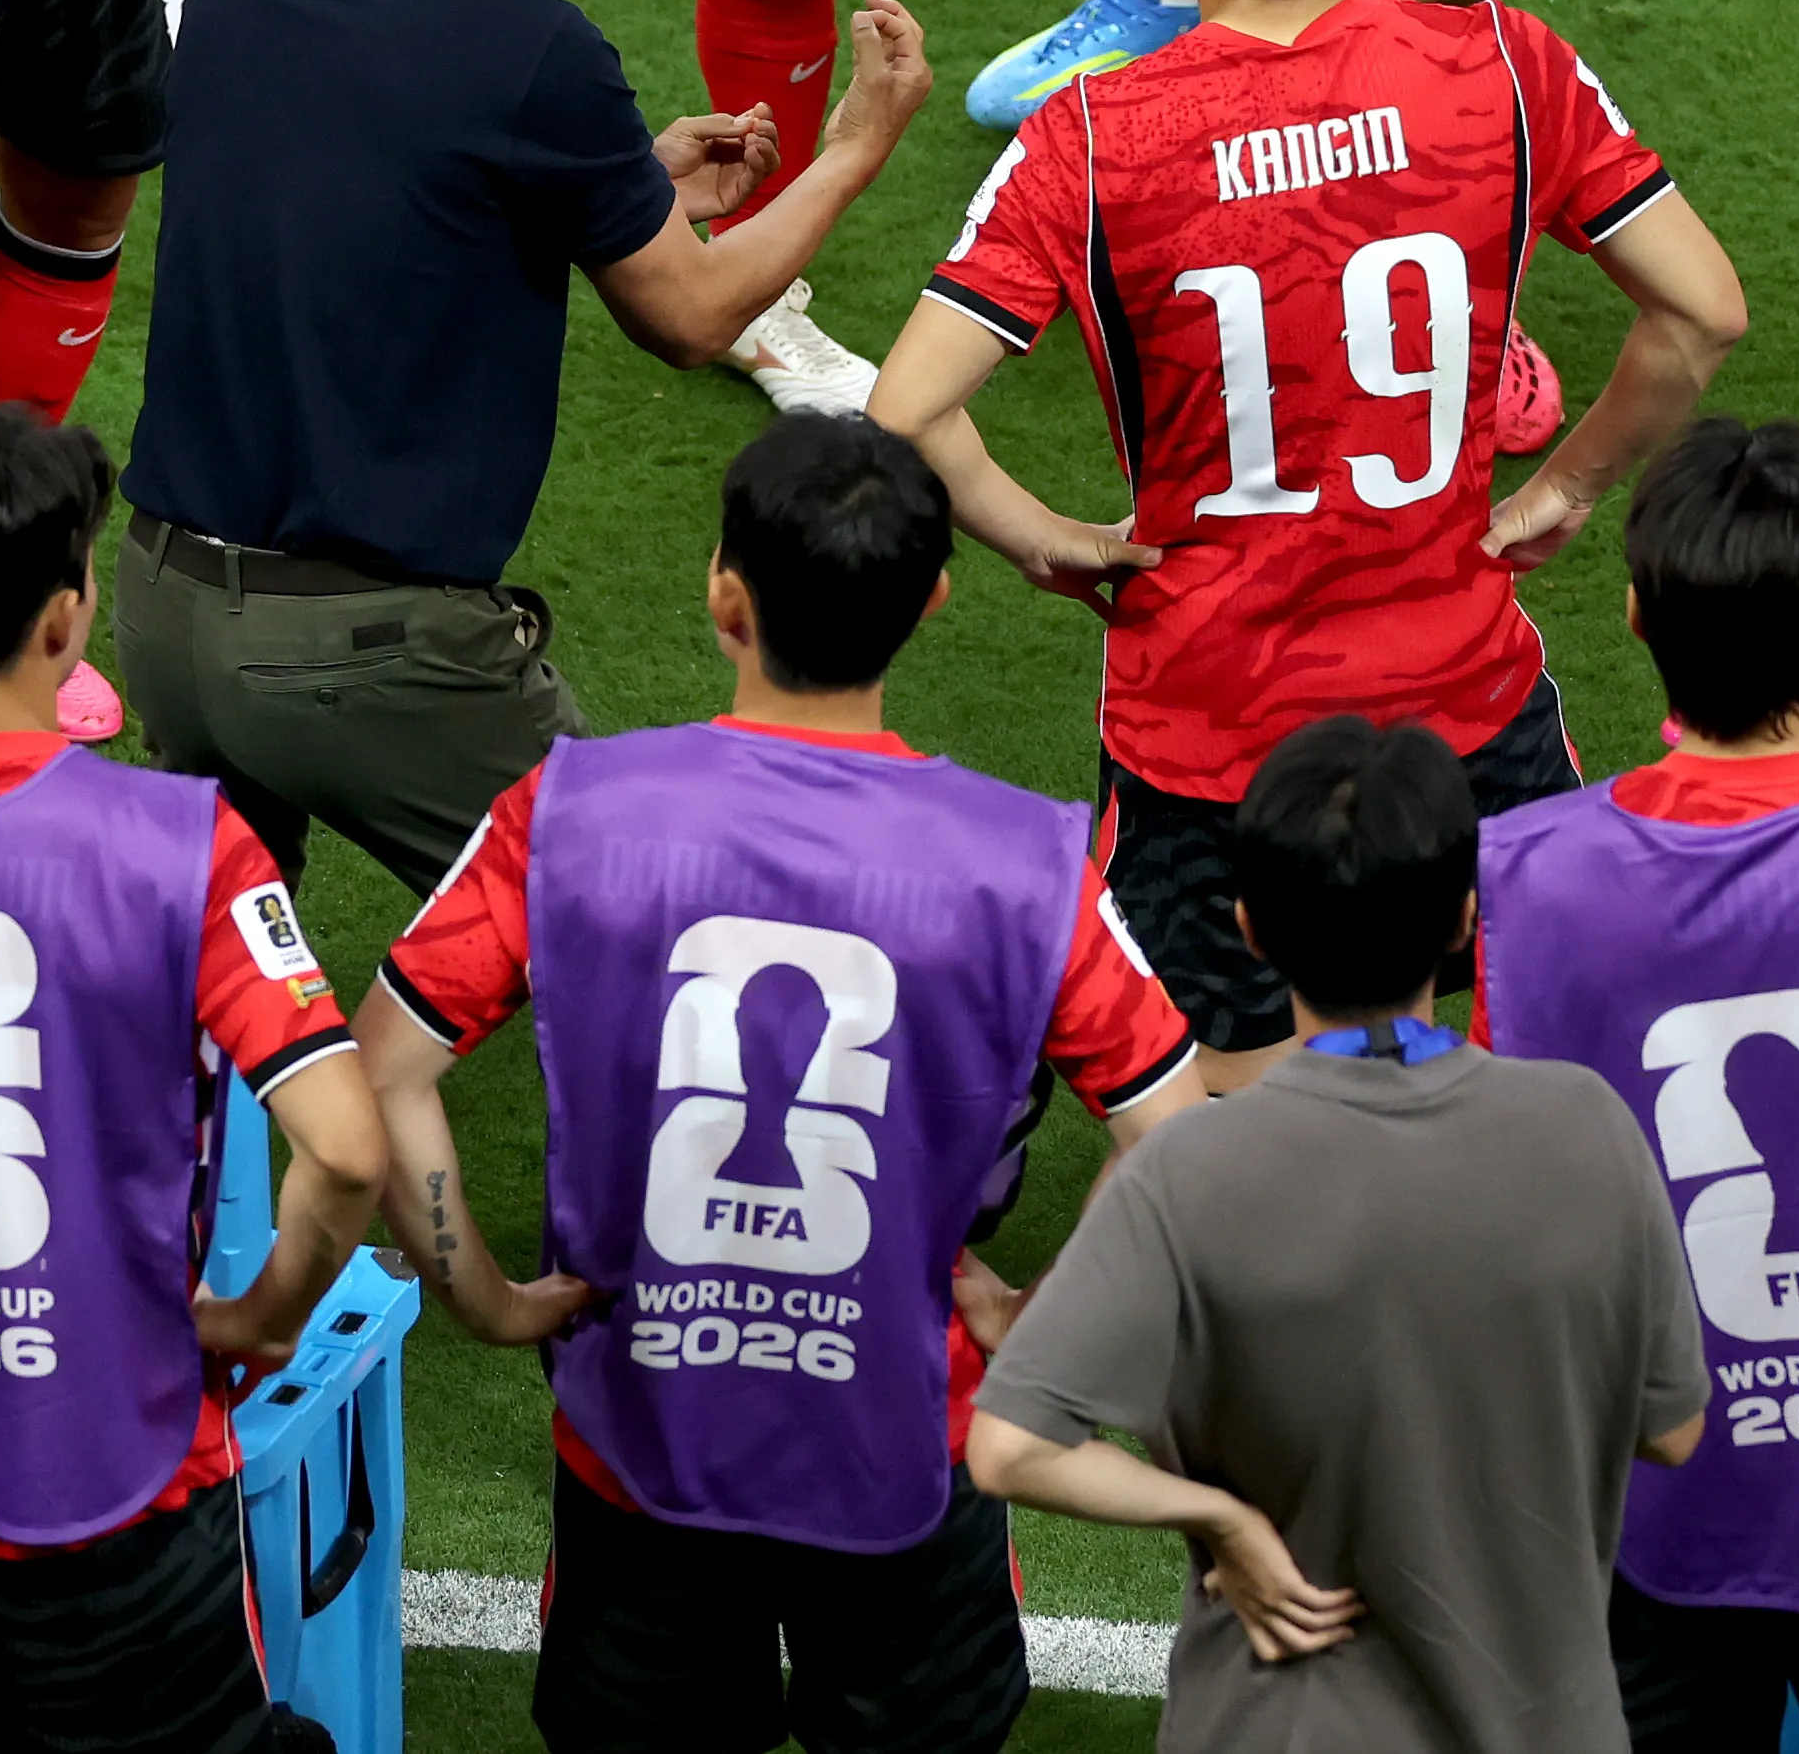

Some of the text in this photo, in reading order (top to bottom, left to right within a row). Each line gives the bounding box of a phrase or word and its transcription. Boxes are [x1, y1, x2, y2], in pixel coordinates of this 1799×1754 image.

[1210, 104, 1410, 204] KANGIN
[1171, 231, 1476, 526] 19
[703, 1198, 809, 1242] FIFA
[634, 1279, 863, 1326] WORLD CUP
[630, 1319, 857, 1382] 2026
